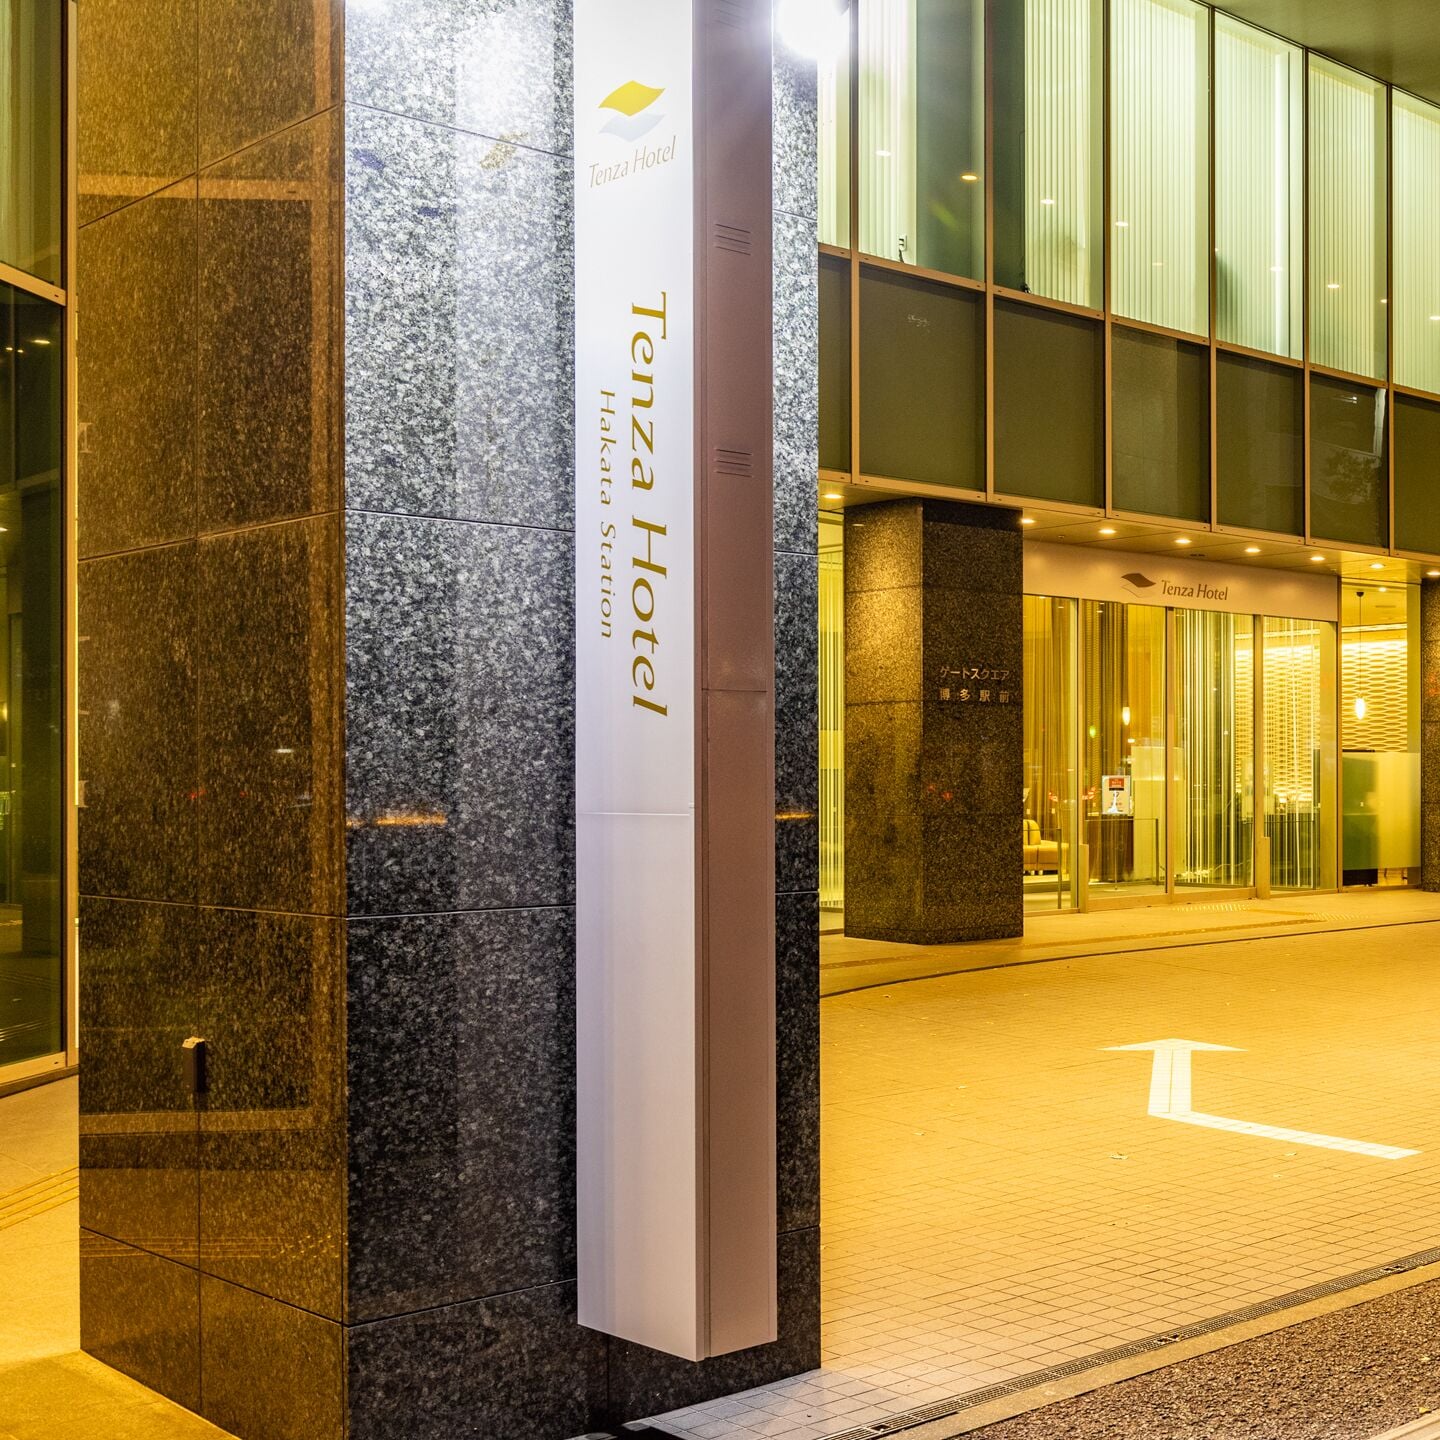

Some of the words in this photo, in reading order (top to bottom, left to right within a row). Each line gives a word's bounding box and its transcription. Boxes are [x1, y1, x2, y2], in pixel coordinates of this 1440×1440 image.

[588, 160, 629, 188] Tenza
[632, 134, 677, 174] Hotel
[631, 291, 667, 491] Tenza
[600, 390, 617, 505] Hakata
[600, 521, 617, 639] Station
[631, 515, 668, 717] Hotel
[1161, 580, 1194, 598] Tenza
[1196, 583, 1229, 601] Hotel
[940, 665, 1010, 681] ゲートスクエア
[940, 687, 1009, 704] 博多駅前
